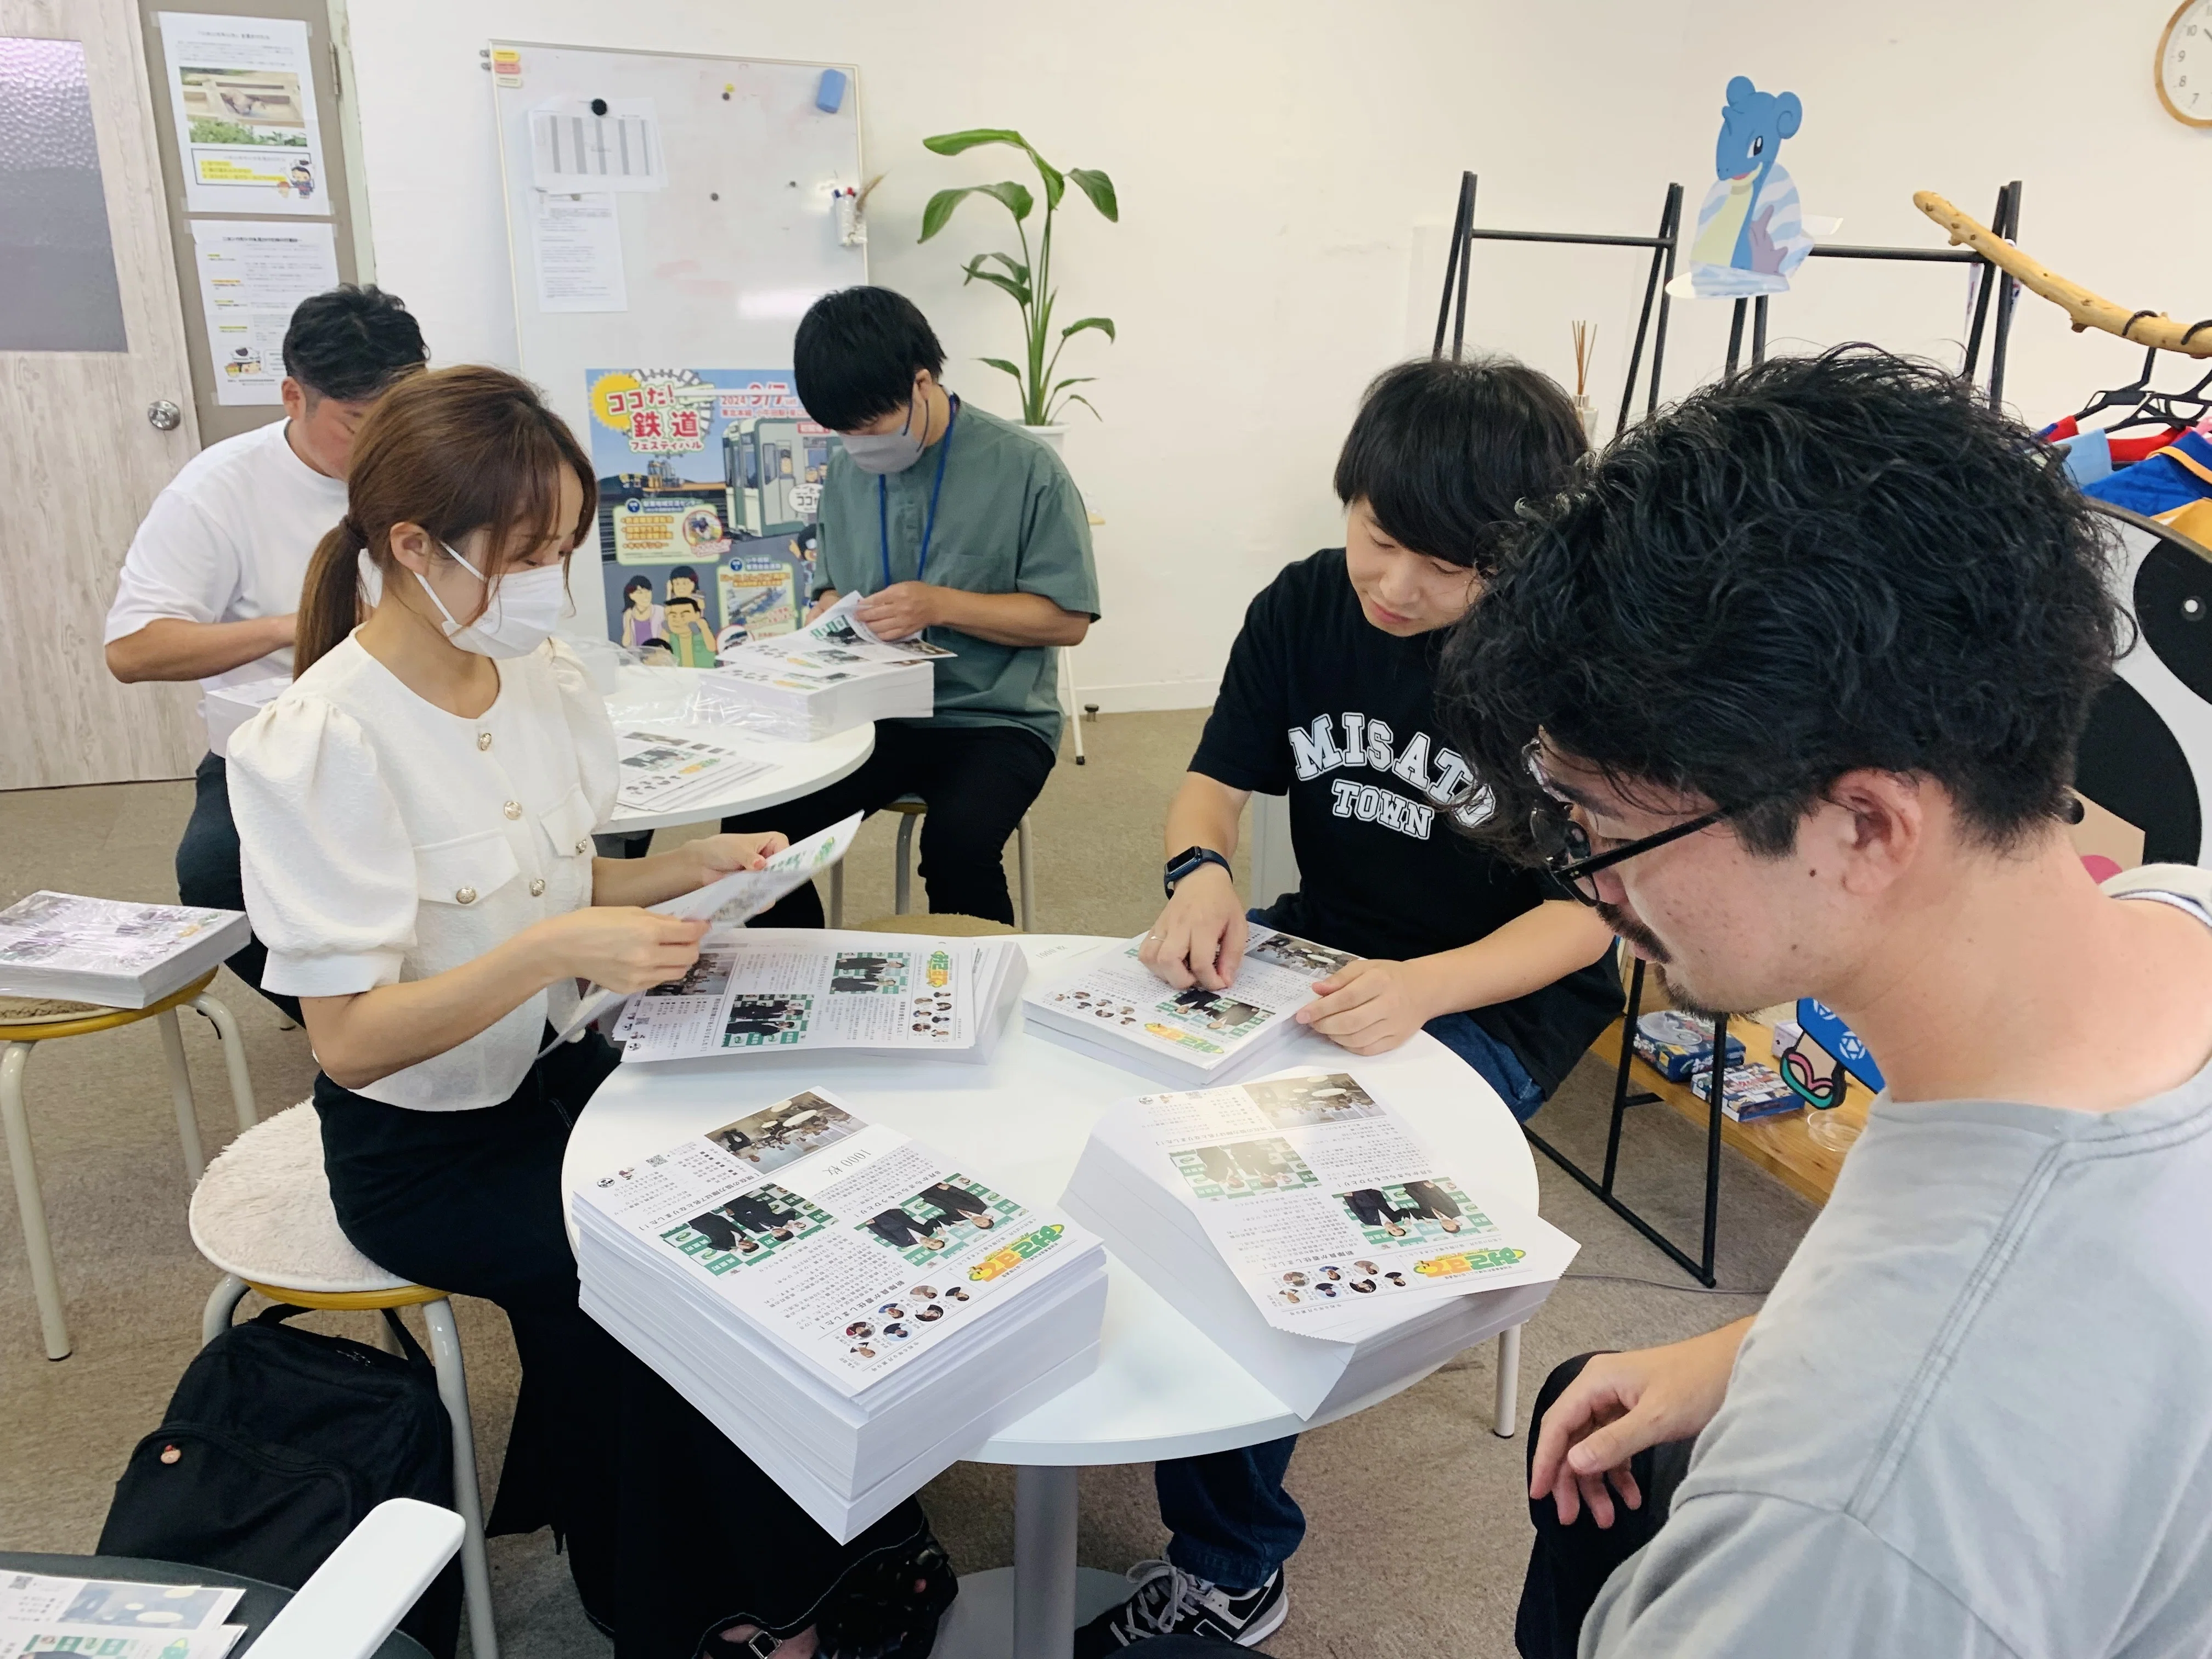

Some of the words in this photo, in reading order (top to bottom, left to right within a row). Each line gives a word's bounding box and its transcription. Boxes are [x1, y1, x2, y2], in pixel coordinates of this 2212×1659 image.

[2187, 25, 2197, 36] 10
[2177, 50, 2186, 62] 9
[2179, 76, 2186, 87] 8
[2192, 93, 2199, 104] 7
[632, 410, 699, 438] 鉄道
[630, 441, 702, 450] フェスティバル
[1331, 779, 1434, 840] TOWN
[1335, 1169, 1434, 1187] 8月からさらにもうひとり！
[851, 1170, 944, 1217] 8月からさらにもうひとり！
[1261, 1250, 1355, 1269] 新隊員が着任しました！
[817, 1280, 906, 1330] 新隊員が着任しました！
